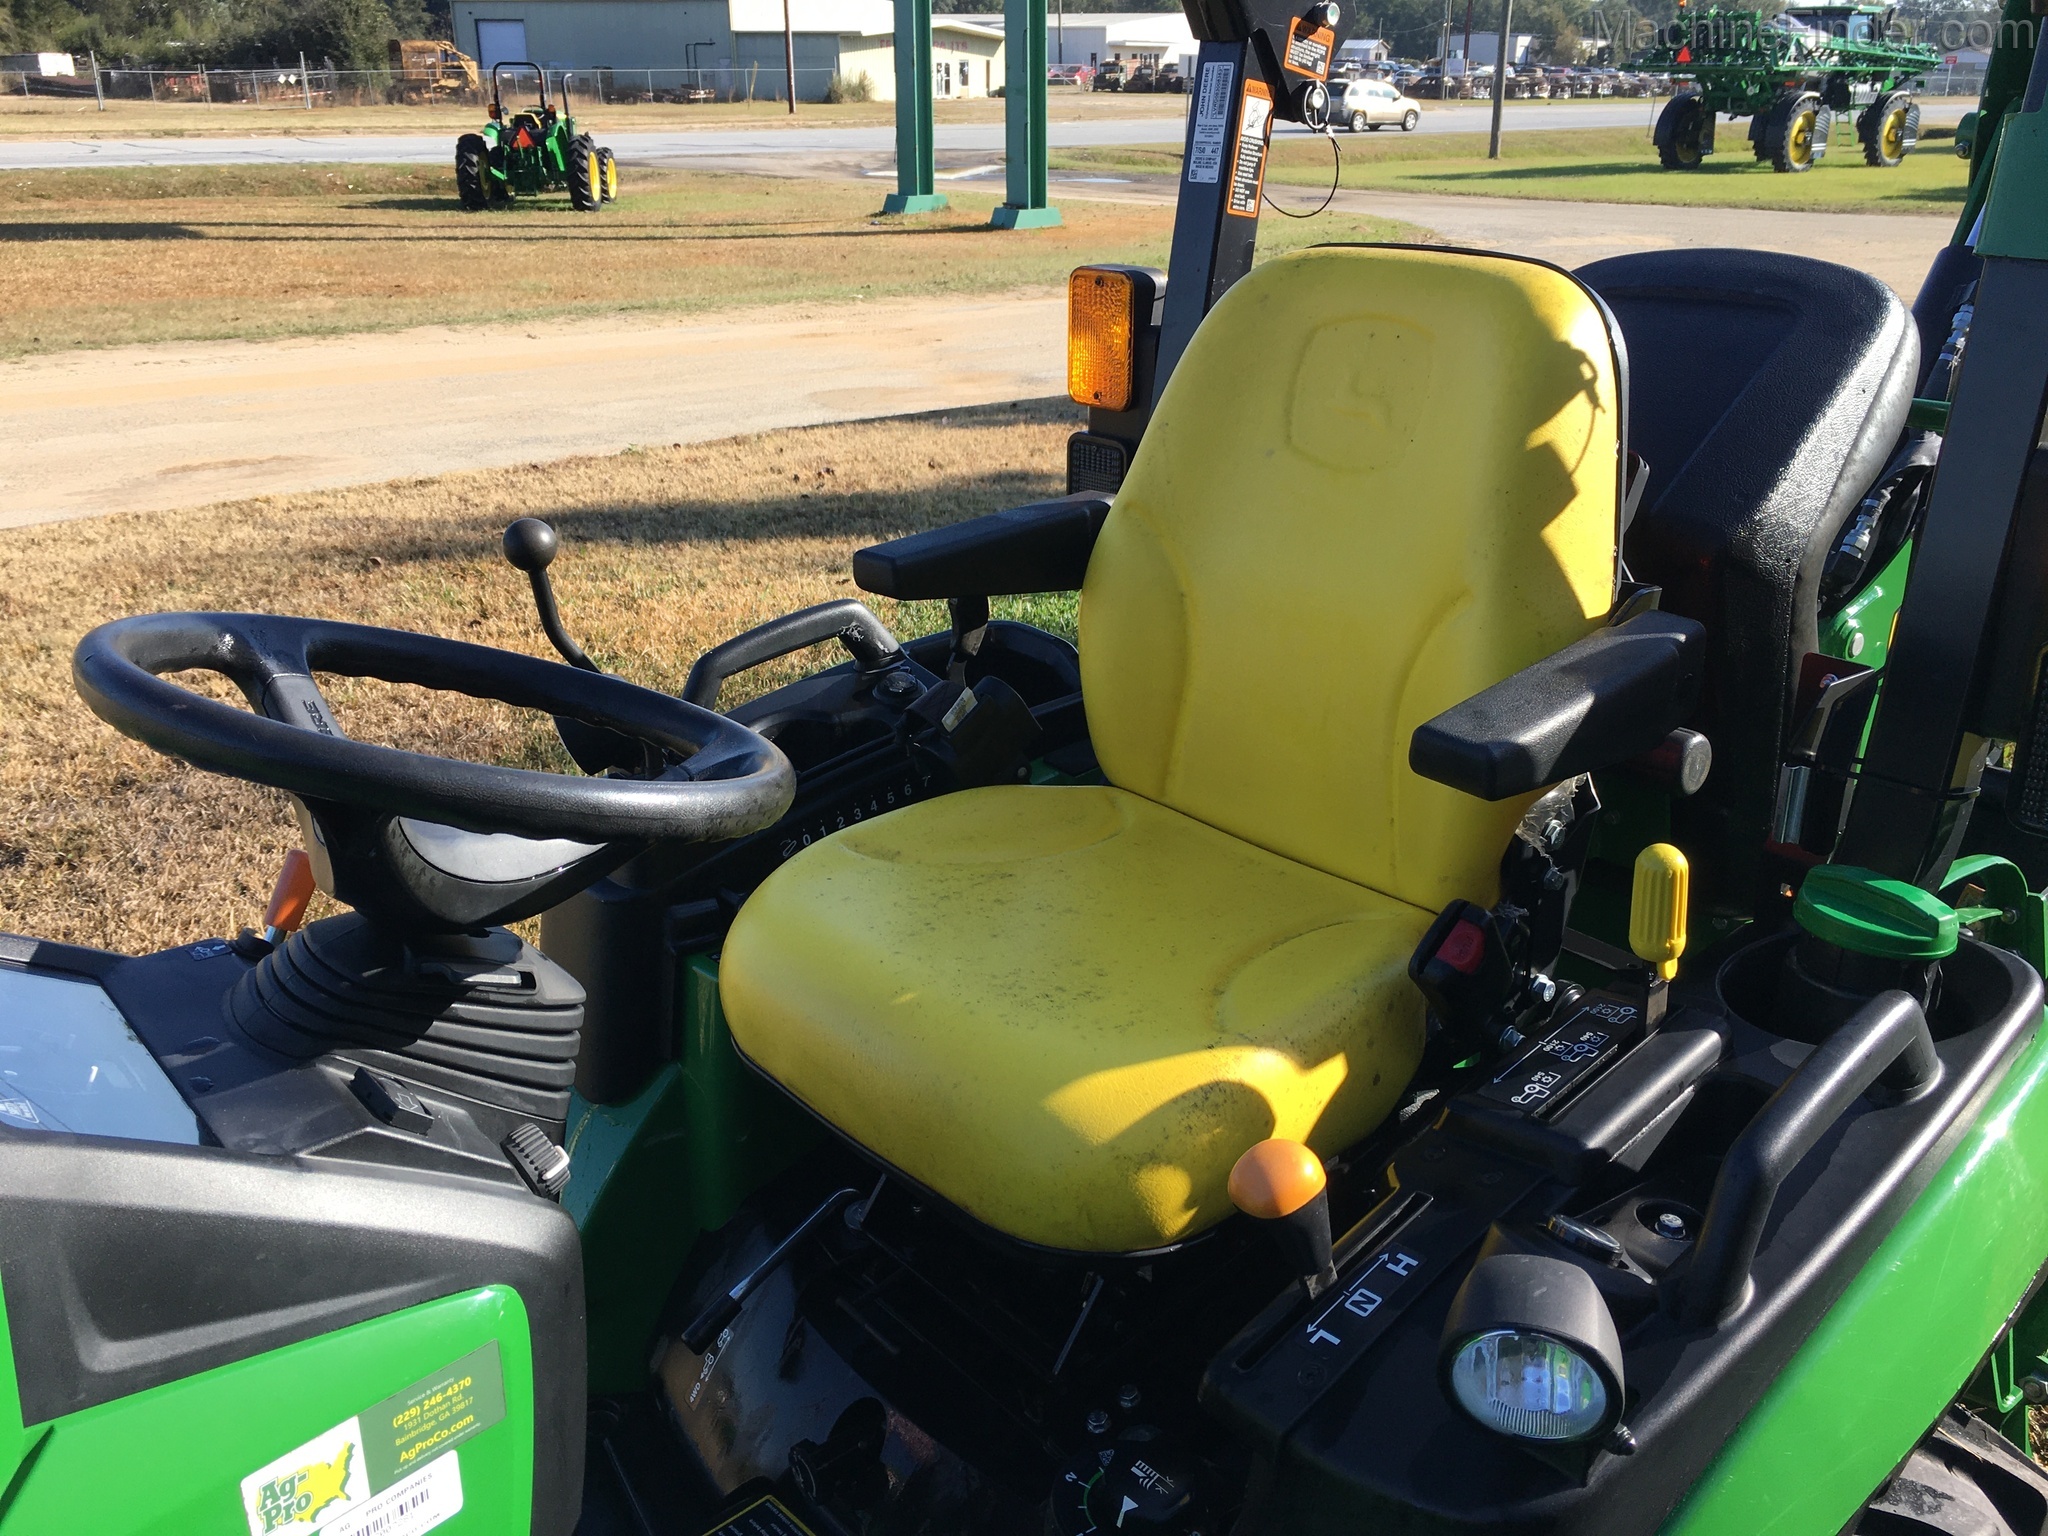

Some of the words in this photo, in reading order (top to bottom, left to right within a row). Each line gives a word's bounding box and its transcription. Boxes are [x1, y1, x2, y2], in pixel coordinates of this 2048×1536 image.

[1202, 66, 1210, 93] DEERE
[803, 834, 811, 846] 0
[820, 826, 827, 836] 1
[837, 816, 845, 828] 2
[854, 808, 862, 820] 3
[870, 800, 878, 811] 4
[888, 792, 894, 804] 5
[904, 784, 912, 795] 6
[922, 776, 930, 786] 7
[1542, 1040, 1560, 1052] 2100
[1580, 1032, 1594, 1042] 540
[1530, 1071, 1545, 1082] 540
[1386, 1253, 1418, 1276] H
[1349, 1292, 1377, 1313] N
[1309, 1329, 1341, 1346] L
[393, 1405, 421, 1428] (229)
[423, 1376, 472, 1408] 246-4370
[407, 1393, 426, 1405] Service
[432, 1377, 454, 1392] Warranty
[689, 1382, 701, 1402] 4WD
[403, 1416, 421, 1432] 1931
[424, 1400, 450, 1420] Dothan
[452, 1393, 464, 1404] Rd.
[395, 1417, 437, 1446] Bainbridge,
[438, 1410, 450, 1422] GA
[400, 1414, 474, 1463] AgProCo.com
[1065, 1472, 1077, 1482] 2
[259, 1470, 308, 1513] Ag-
[339, 1522, 350, 1533] AG
[366, 1502, 383, 1516] PRO
[386, 1473, 432, 1505] COMPANIES
[262, 1491, 313, 1535] Pro
